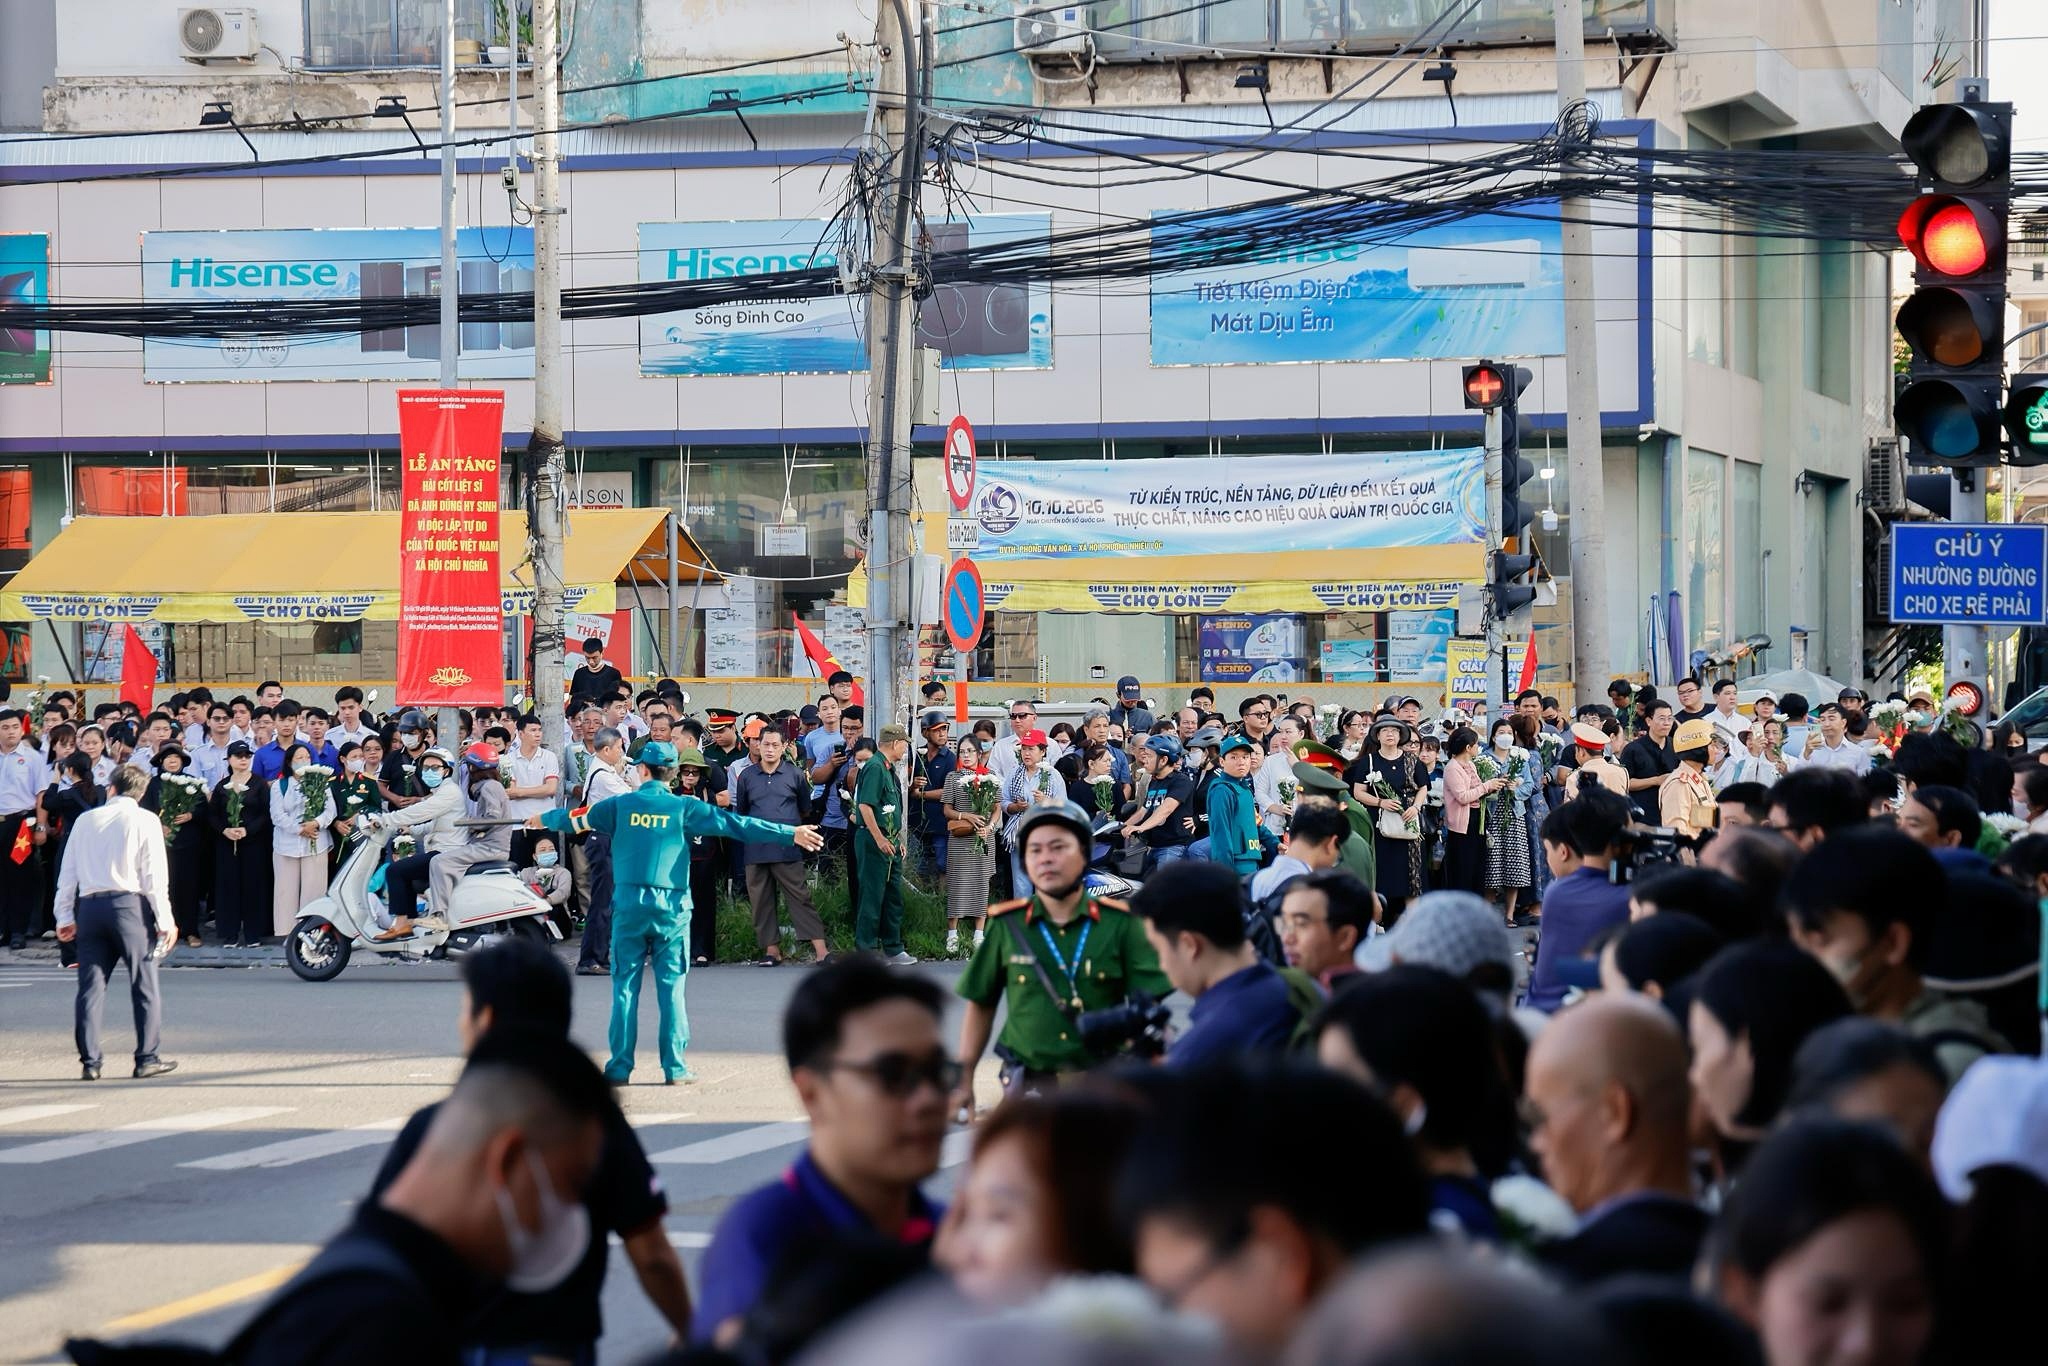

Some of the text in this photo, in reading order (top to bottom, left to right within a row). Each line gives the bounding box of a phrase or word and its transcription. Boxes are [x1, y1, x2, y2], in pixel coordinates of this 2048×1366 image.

[171, 257, 338, 288] Hisense
[1194, 279, 1350, 305] Tiết Kiệm Điện
[695, 309, 732, 327] Sống
[774, 310, 804, 323] Cao
[1211, 307, 1333, 338] Mát Dịu Êm
[408, 453, 496, 472] LỄ AN TÁNG
[437, 478, 453, 492] CỐT
[455, 478, 471, 494] LIỆT
[1129, 477, 1436, 505] TỪ KIẾN TRÚC, NỀN TẢNG, DỮ LIỆU ĐẾN KẾT QUẢ
[421, 500, 438, 512] ANH
[440, 498, 462, 512] DŨNG
[464, 500, 474, 512] HY
[477, 500, 497, 512] SINH
[1026, 499, 1104, 516] 10.10.2026
[1113, 496, 1454, 530] THỰC CHẤT, NÂNG CAO HIỆU QUẢ QUẢN TRỊ QUỐC GIA
[476, 520, 487, 532] DO
[406, 536, 498, 554] CỦA TỔ QUỐC VIỆT NAM
[1935, 533, 2004, 557] CHÚ Ý
[444, 558, 461, 571] CHỦ
[463, 558, 488, 572] NGHĨA
[1902, 561, 2036, 587] NHƯỜNG ĐƯỜNG
[1122, 594, 1161, 610] CHỢ
[1347, 593, 1385, 608] CHỢ
[1904, 590, 2031, 616] CHO XE RẼ PHẢI
[54, 604, 90, 618] CHỢ
[267, 605, 302, 620] CHỢ
[576, 624, 607, 639] THẤP
[1215, 621, 1252, 629] SENKO
[1215, 664, 1252, 673] SENKO
[630, 813, 670, 828] DQTT
